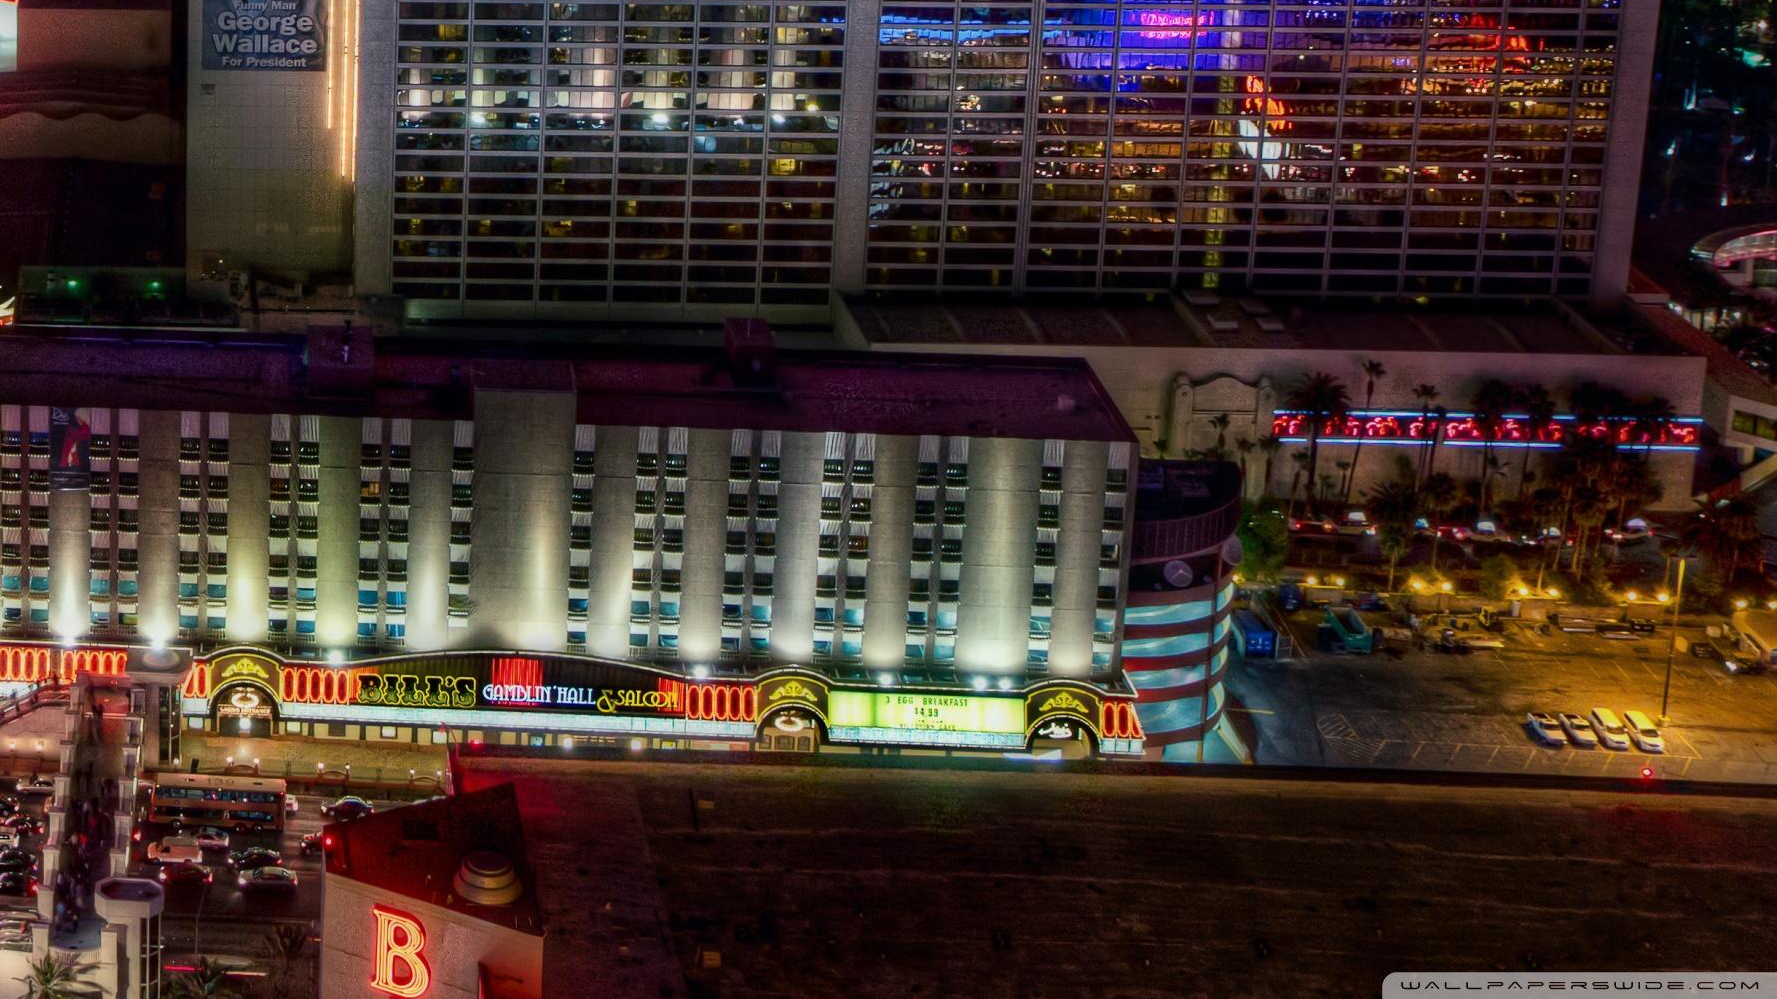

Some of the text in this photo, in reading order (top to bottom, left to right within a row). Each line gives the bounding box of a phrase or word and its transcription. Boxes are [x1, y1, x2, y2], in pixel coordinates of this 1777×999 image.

[235, 1, 296, 11] Funny Man
[217, 11, 314, 36] George
[212, 33, 318, 54] Wallace
[223, 56, 307, 67] For President
[357, 673, 477, 708] BILL'S
[557, 687, 597, 705] HALL
[615, 690, 679, 710] SALOON
[897, 696, 914, 705] EGG
[922, 697, 968, 707] BREAKFAST
[370, 904, 431, 998] B
